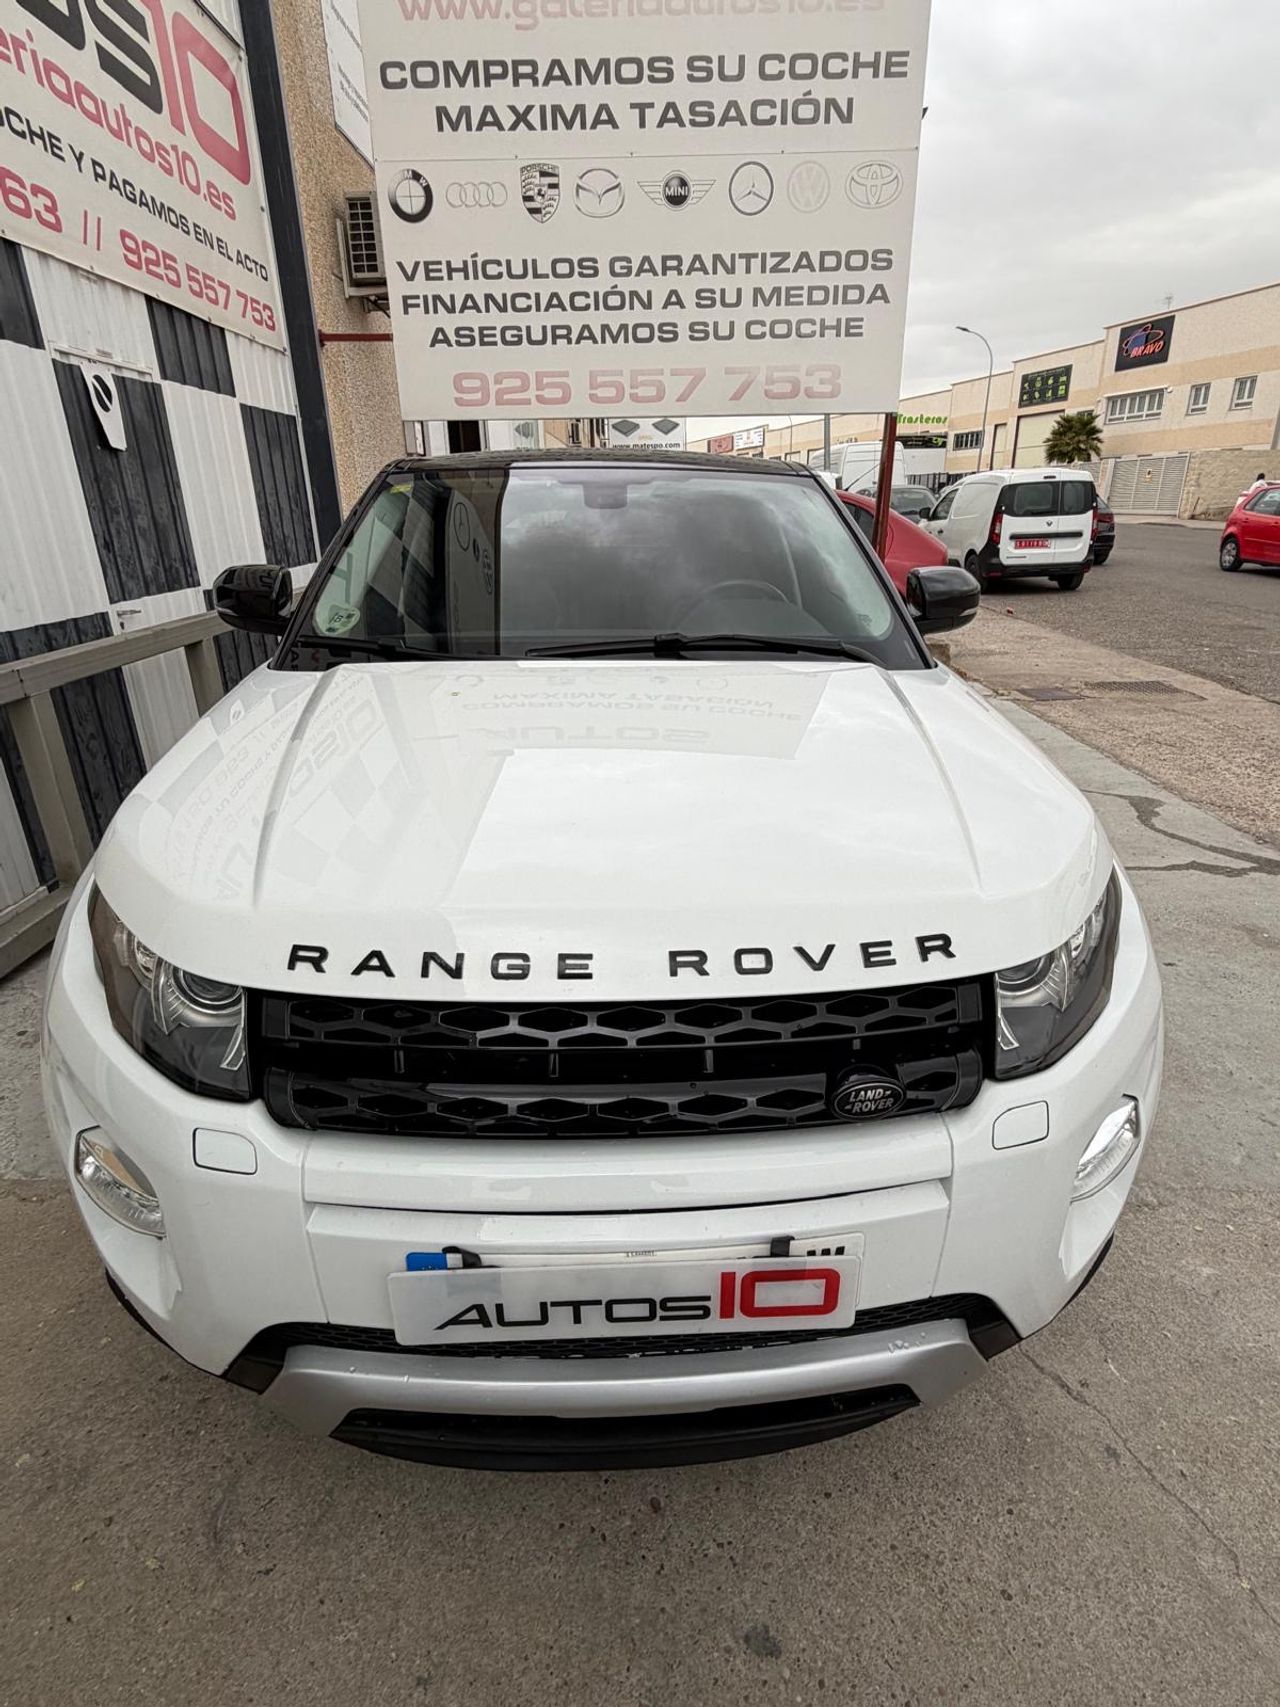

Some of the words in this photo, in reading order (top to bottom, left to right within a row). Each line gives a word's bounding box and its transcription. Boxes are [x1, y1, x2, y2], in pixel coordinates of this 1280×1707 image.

[379, 54, 675, 90] COMPRAMOS
[686, 54, 746, 83] SU
[757, 50, 911, 81] COCHE
[15, 0, 251, 186] S10
[434, 103, 620, 133] MAXIMA
[629, 90, 855, 129] TASACIÓN
[0, 105, 66, 163] CHE
[67, 143, 85, 173] Y
[90, 157, 190, 237] PAGAMOS
[193, 222, 215, 250] EN
[215, 236, 234, 262] EL
[235, 249, 269, 282] ACTO
[665, 185, 689, 197] MINI
[119, 228, 182, 290] 925
[185, 263, 231, 310] 557
[235, 289, 276, 332] 753
[395, 252, 600, 282] VEHÍCULOS
[608, 248, 895, 278] GARANTIZADOS
[401, 284, 653, 315] FINANCIACIÓN
[661, 289, 686, 310] A
[693, 286, 744, 309] SU
[752, 283, 891, 308] MEDIDA
[429, 321, 680, 348] ASEGURAMOS
[688, 320, 737, 342] SU
[743, 316, 866, 340] COCHE
[1129, 340, 1165, 358] BRAVO
[452, 369, 573, 408] 925
[587, 367, 708, 406] 557
[723, 364, 842, 402] 753
[286, 943, 594, 981] RANGE
[667, 932, 957, 977] ROVER
[849, 1088, 884, 1102] LAND
[852, 1098, 894, 1113] ROVER
[433, 1267, 841, 1330] AUTOS10
